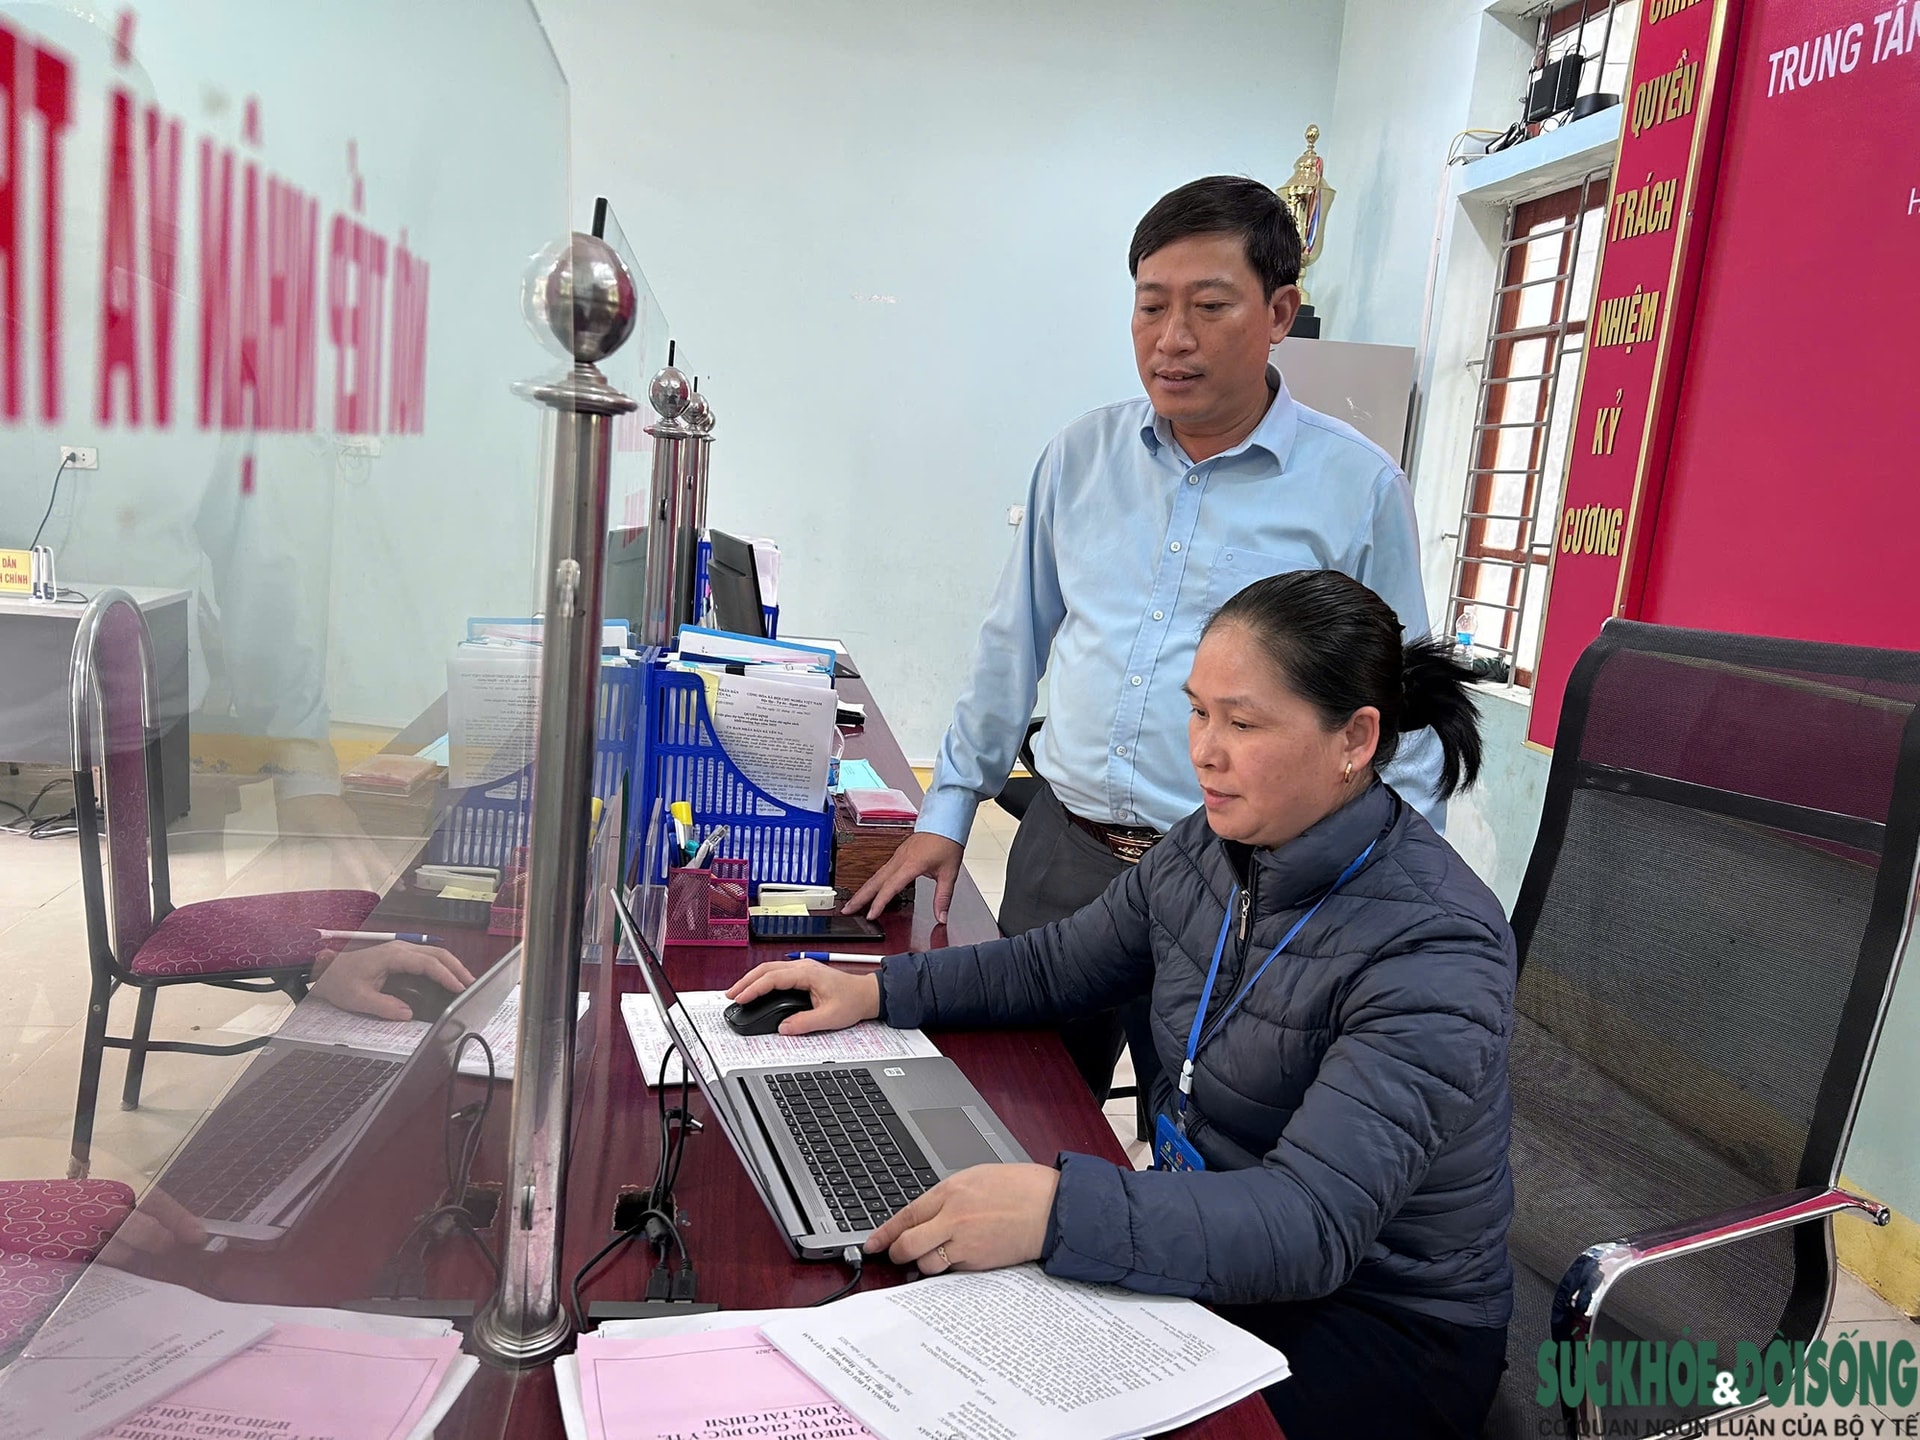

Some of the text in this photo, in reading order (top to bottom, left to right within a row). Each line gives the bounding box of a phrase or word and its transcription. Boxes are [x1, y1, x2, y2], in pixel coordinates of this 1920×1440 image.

[1768, 23, 1864, 98] TRUNG
[1631, 48, 1699, 138] QUYỀN
[1612, 172, 1677, 242] TRÁCH
[1595, 284, 1660, 354] NHIỆM
[1592, 388, 1623, 455] KỶ
[1561, 503, 1623, 556] CƯƠNG
[706, 1415, 759, 1429] CHÍNH
[748, 1423, 789, 1435] GIÁO
[763, 1412, 792, 1424] TÀI
[793, 1407, 828, 1418] HỘI,
[811, 1428, 857, 1439] THEO
